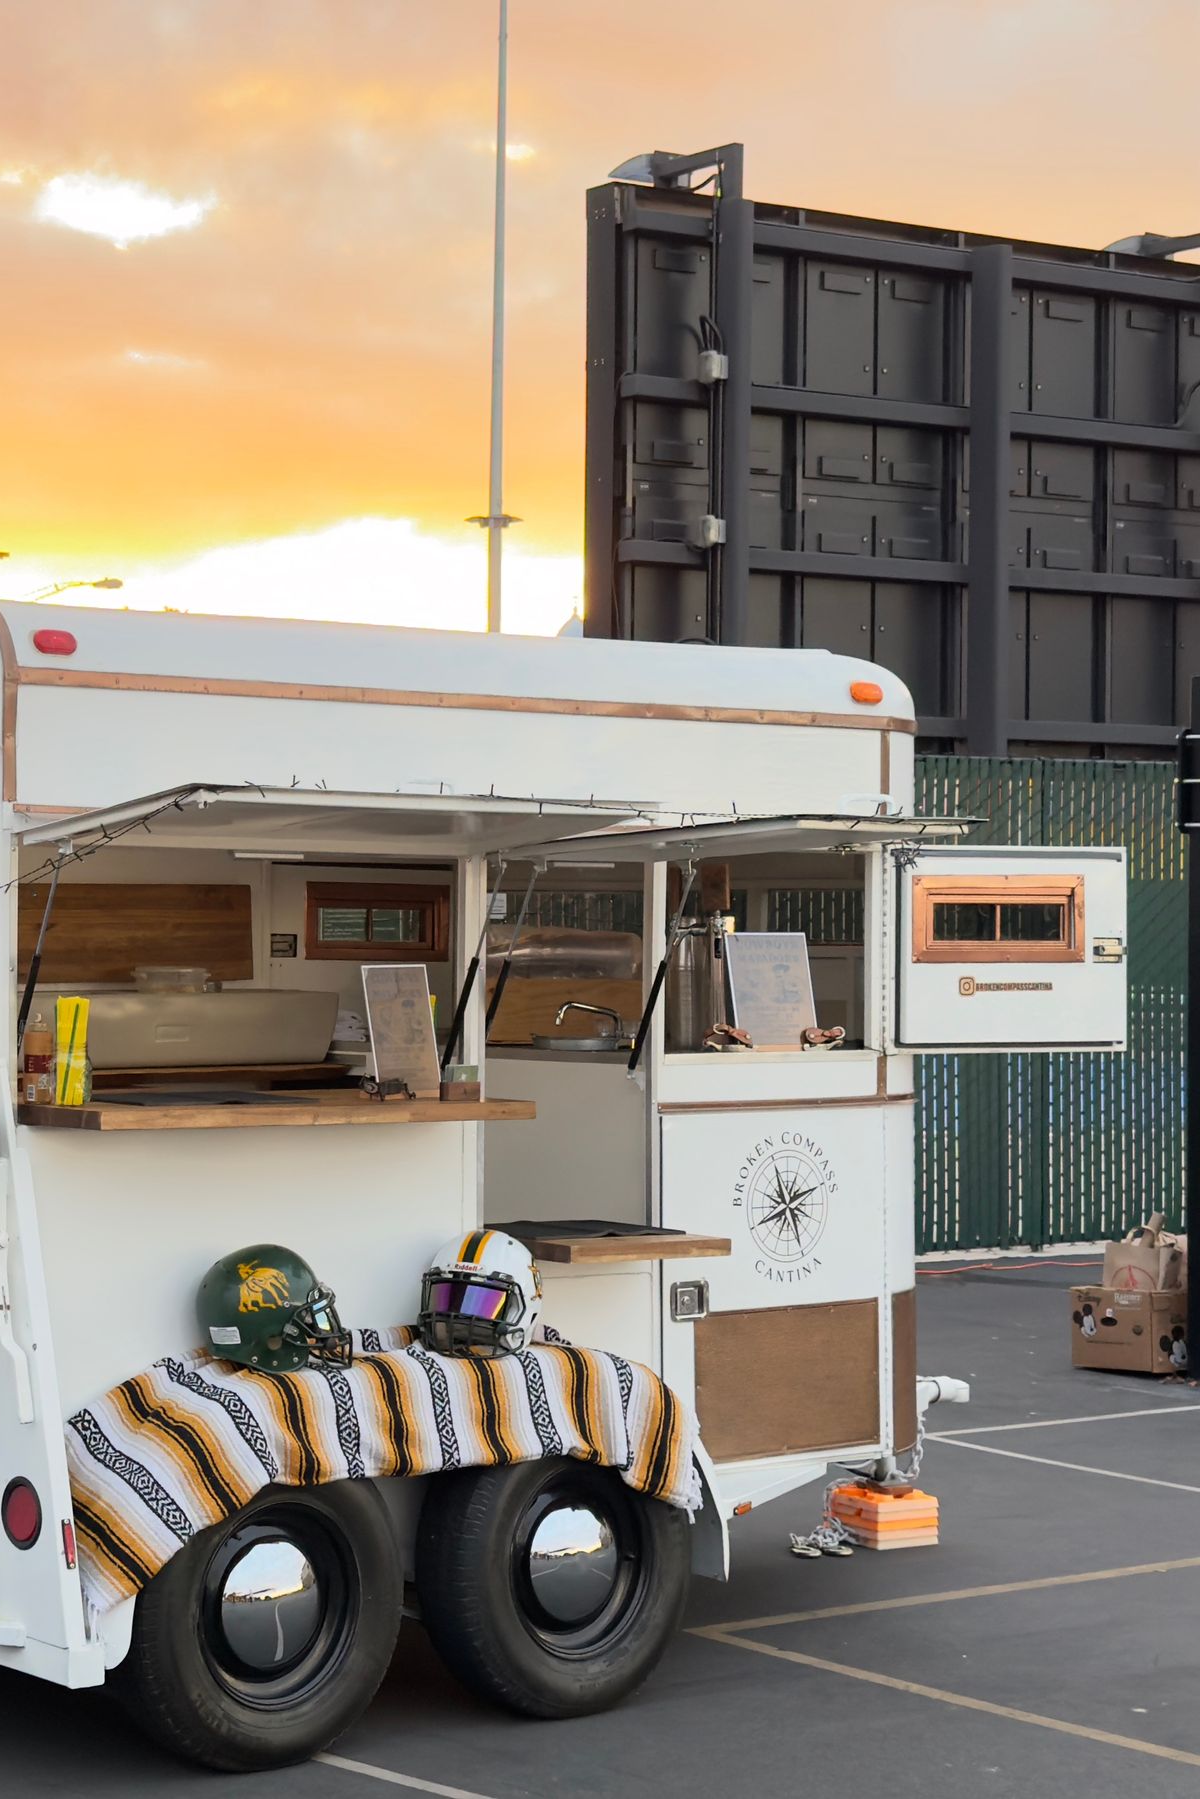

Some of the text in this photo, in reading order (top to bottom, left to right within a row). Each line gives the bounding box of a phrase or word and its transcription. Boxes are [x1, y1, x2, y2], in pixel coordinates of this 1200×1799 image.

[732, 1131, 839, 1207] BROKEN COMPASS
[754, 1257, 822, 1283] CANTINA
